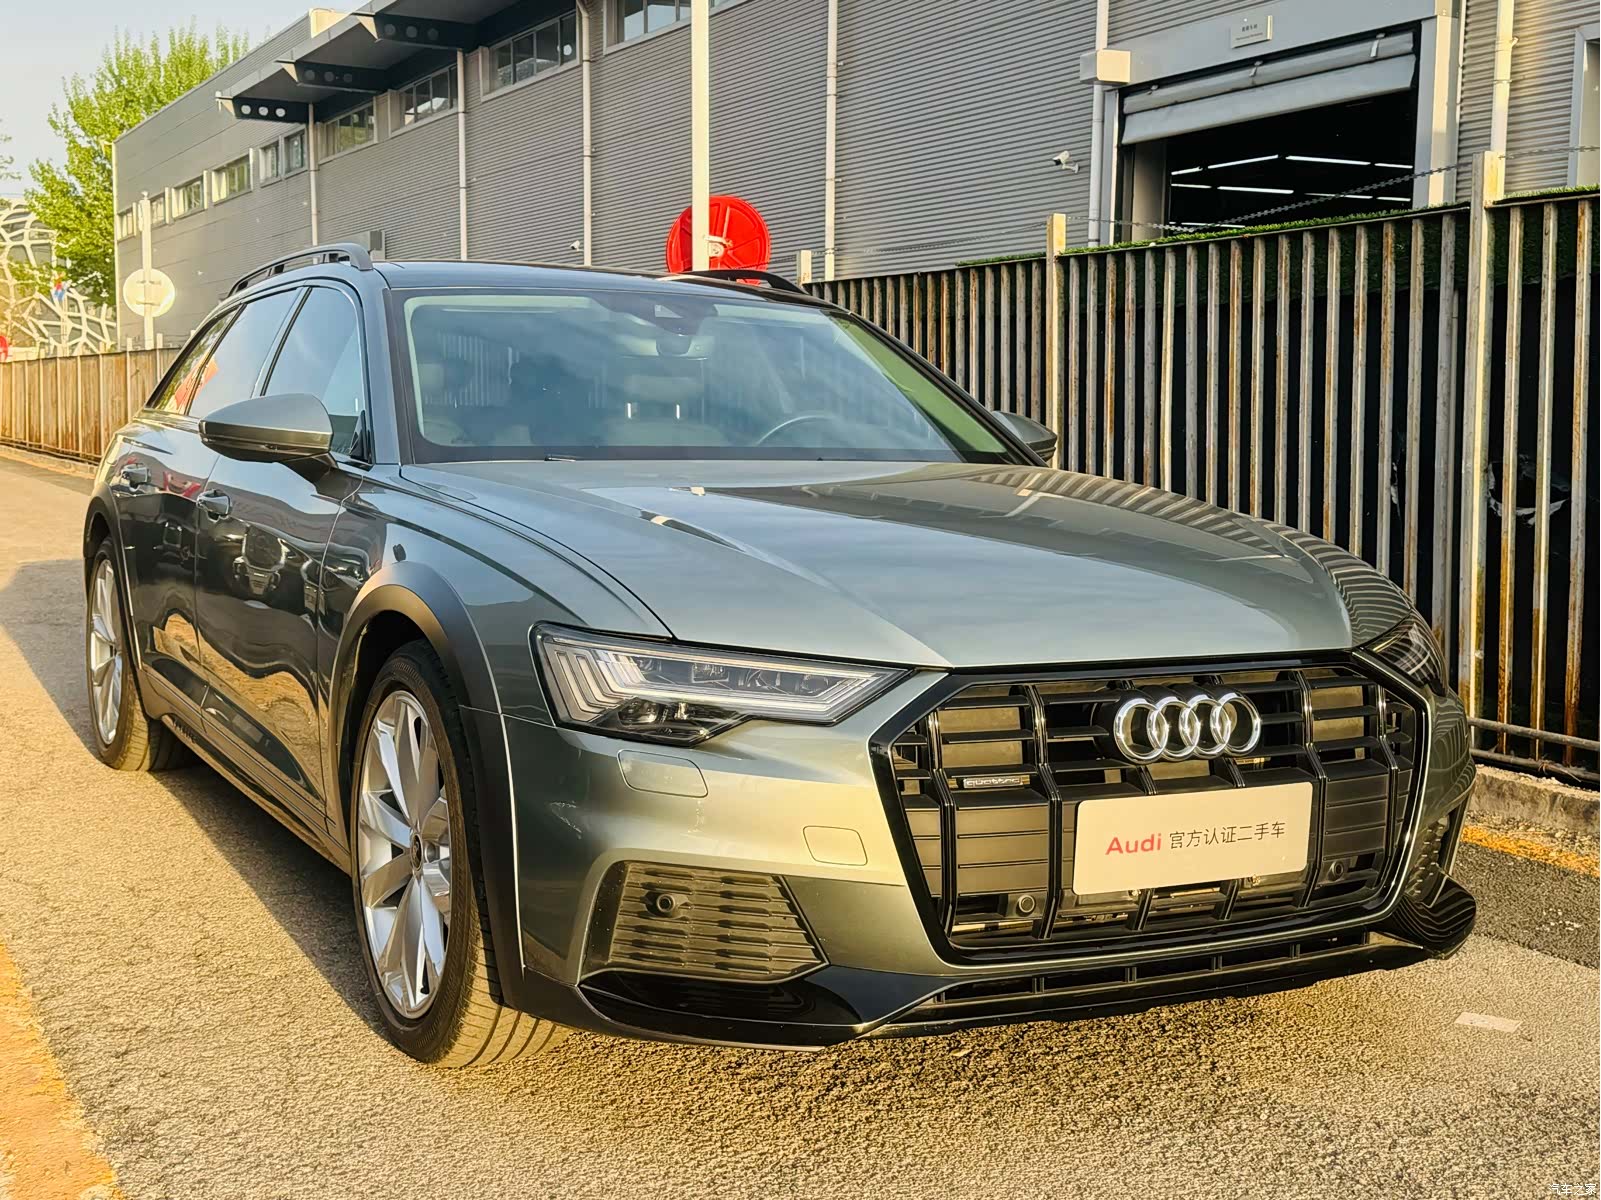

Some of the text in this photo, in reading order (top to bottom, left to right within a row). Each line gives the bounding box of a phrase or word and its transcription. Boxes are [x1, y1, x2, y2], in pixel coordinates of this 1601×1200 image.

[1105, 820, 1286, 855] Audi 官方认证二手车
